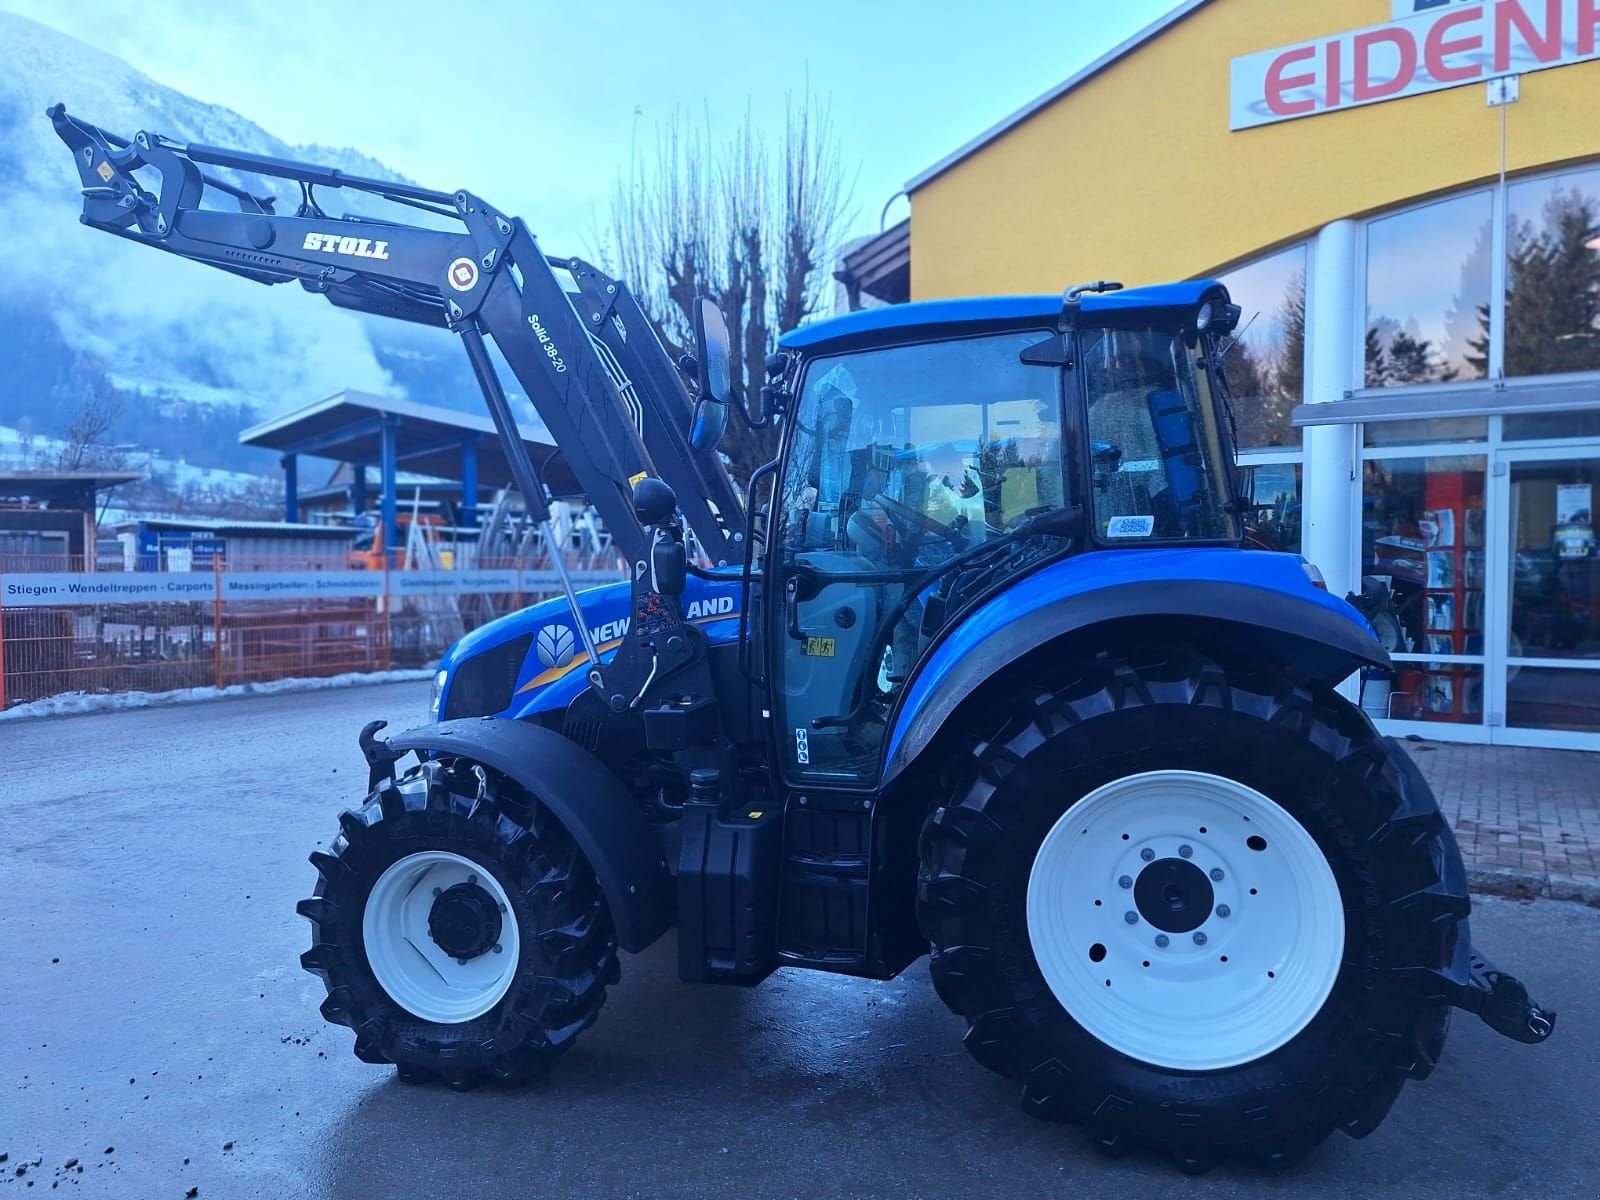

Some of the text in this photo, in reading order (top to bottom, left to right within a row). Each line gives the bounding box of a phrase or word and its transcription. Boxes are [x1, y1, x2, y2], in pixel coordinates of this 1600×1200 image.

[303, 232, 390, 260] STOLL
[528, 314, 567, 372] Solid 38-20
[8, 584, 57, 596] Stiegen
[68, 583, 157, 594] Wendeltreppen
[167, 581, 213, 592] Carports
[589, 616, 630, 645] NEW
